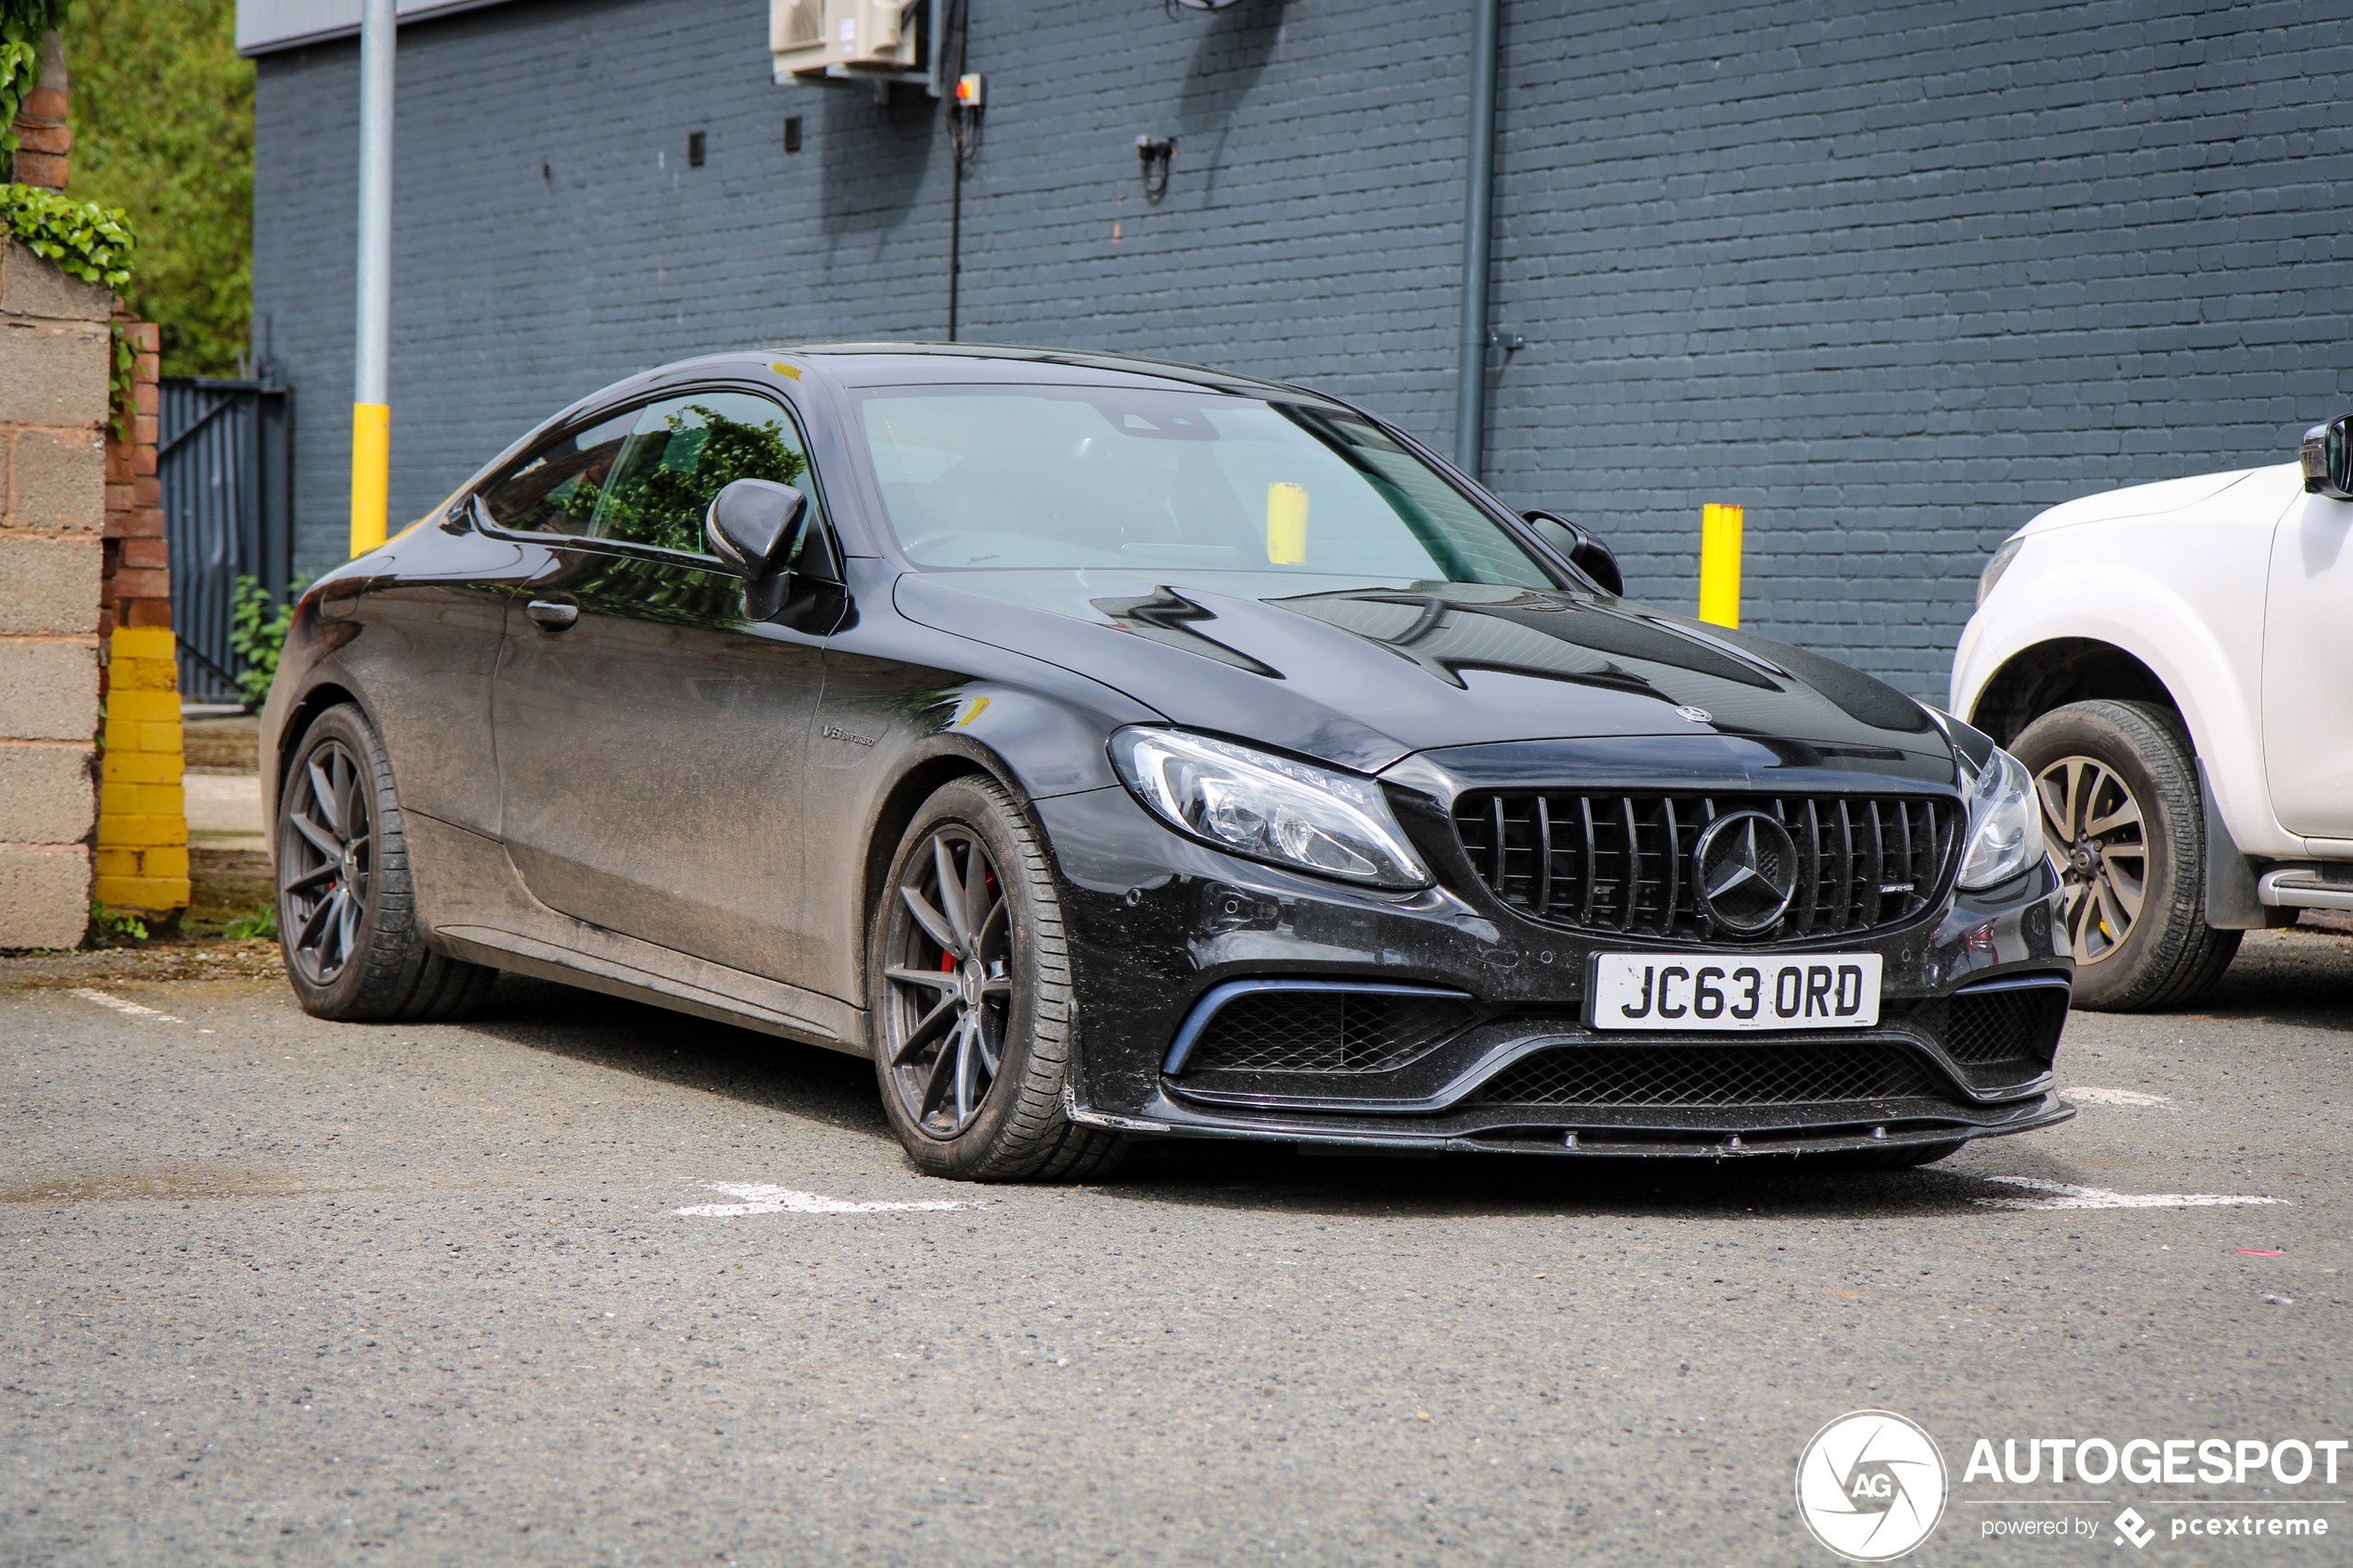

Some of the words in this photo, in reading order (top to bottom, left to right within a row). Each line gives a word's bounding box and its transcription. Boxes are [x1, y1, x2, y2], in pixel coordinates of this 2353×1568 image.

[823, 725, 842, 739] V8
[842, 732, 875, 746] BITURBO
[1621, 966, 1761, 1019] JC63
